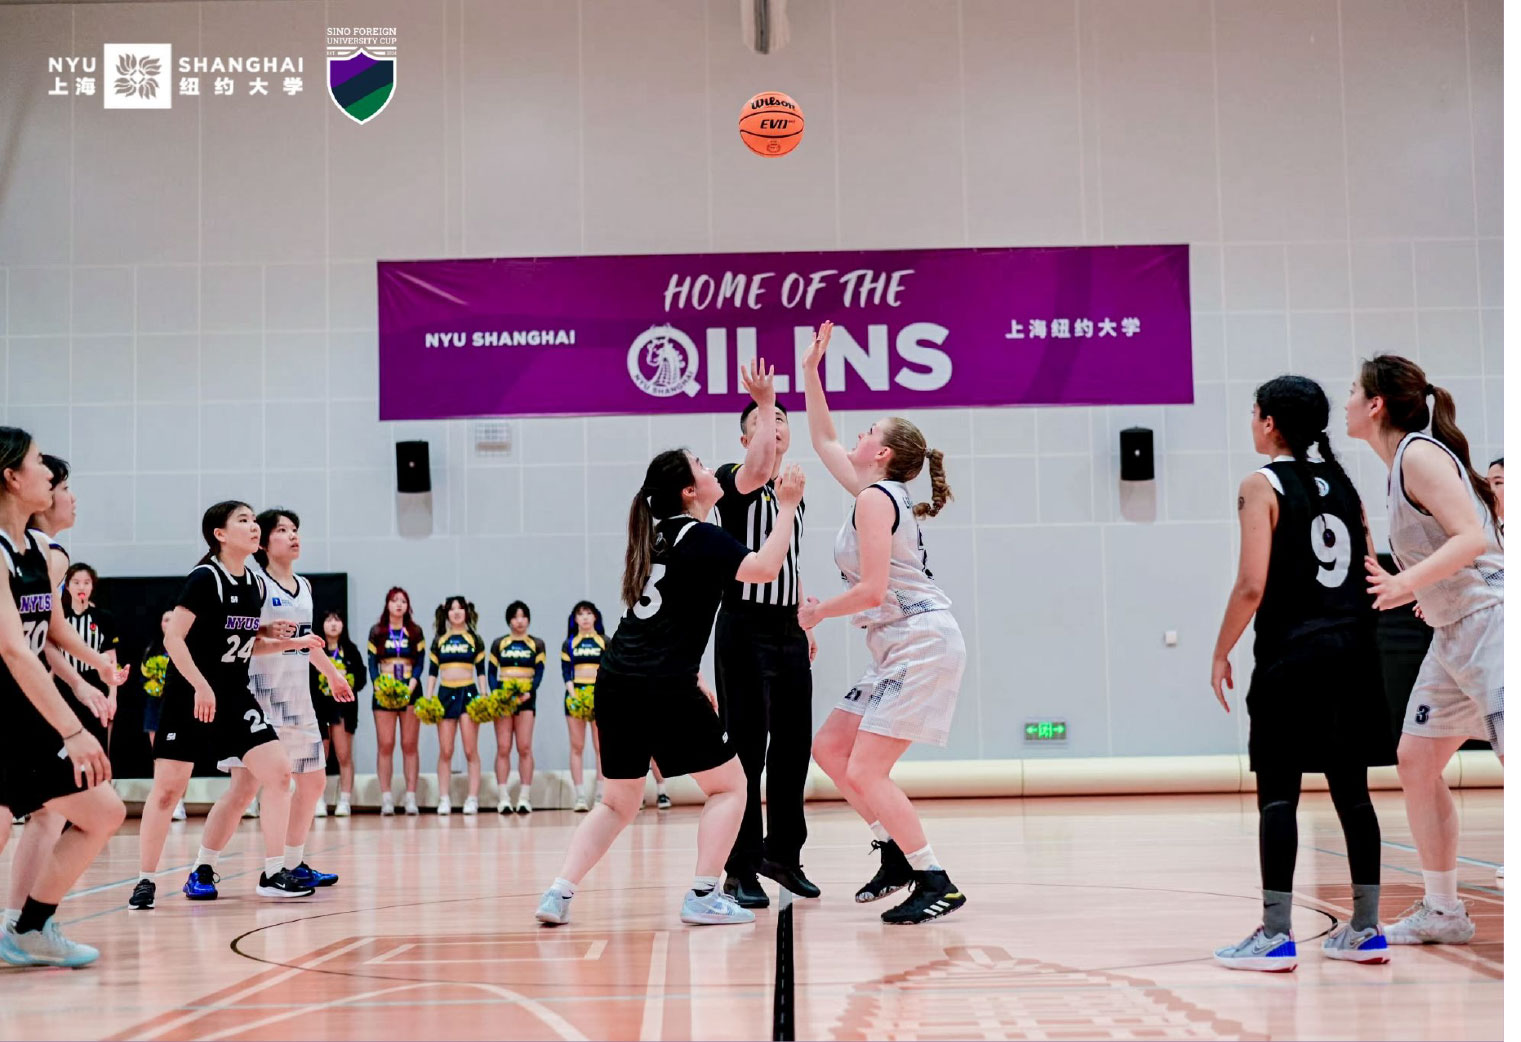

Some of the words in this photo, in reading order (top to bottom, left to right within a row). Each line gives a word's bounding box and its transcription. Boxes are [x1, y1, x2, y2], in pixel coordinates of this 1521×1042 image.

[751, 96, 796, 110] Wilson
[663, 271, 776, 313] HOME
[781, 269, 839, 311] OF
[838, 269, 915, 308] THE
[425, 332, 467, 348] NYU
[471, 329, 576, 347] SHANGHAI
[1005, 317, 1141, 339] 上海纽约大学
[627, 322, 953, 398] QILINS
[1311, 513, 1351, 588] 9
[20, 593, 53, 614] NYUS
[221, 634, 257, 663] 24
[1415, 704, 1431, 725] 3
